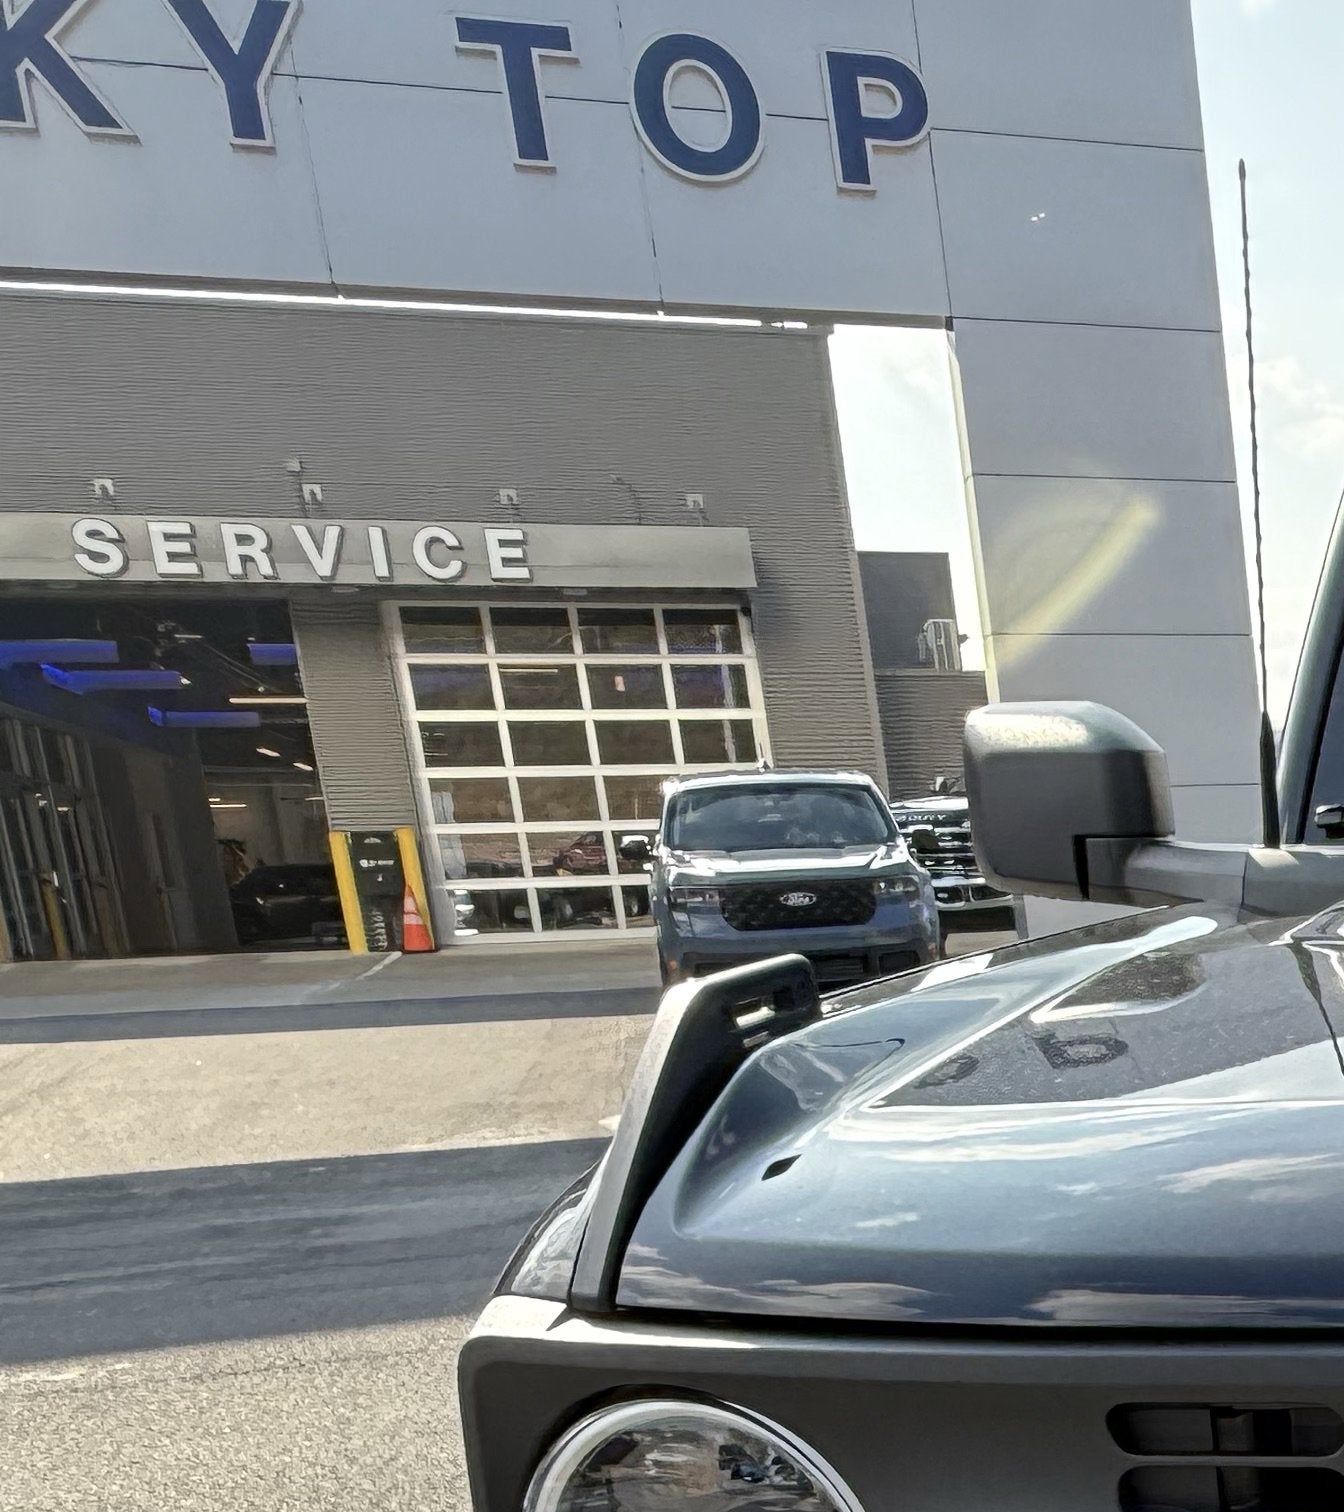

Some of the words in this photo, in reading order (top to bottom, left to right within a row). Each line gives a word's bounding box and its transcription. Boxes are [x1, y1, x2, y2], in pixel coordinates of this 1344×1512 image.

[0, 0, 291, 142] KY
[454, 15, 930, 190] TOP
[71, 517, 532, 581] SERVICE
